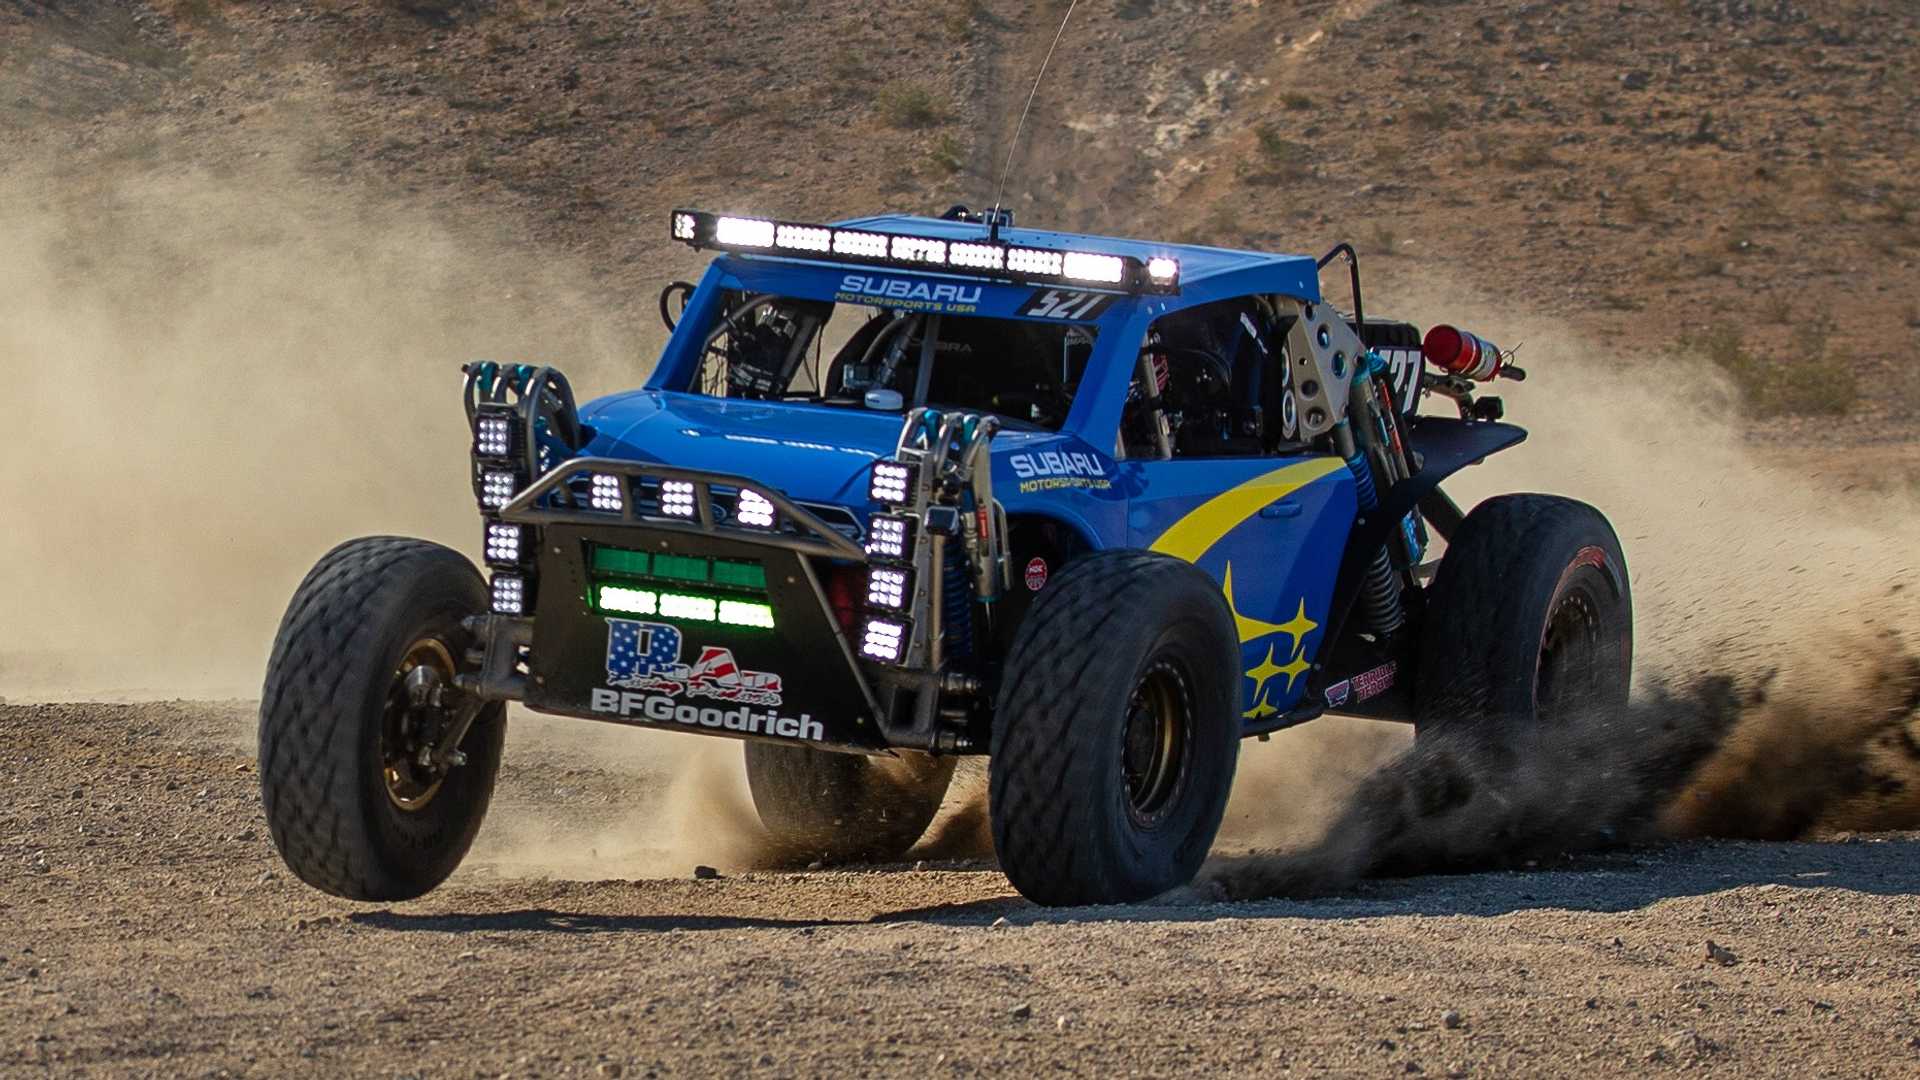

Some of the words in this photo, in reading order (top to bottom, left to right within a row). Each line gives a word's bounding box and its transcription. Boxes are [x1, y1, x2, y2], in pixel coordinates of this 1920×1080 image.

[834, 292, 942, 312] MOTORSPORTS
[946, 303, 976, 312] USA
[840, 275, 982, 303] SUBARU
[1010, 452, 1104, 478] SUBARU
[1020, 477, 1089, 494] MOTORSPORTS
[591, 687, 824, 741] BFGoodrich
